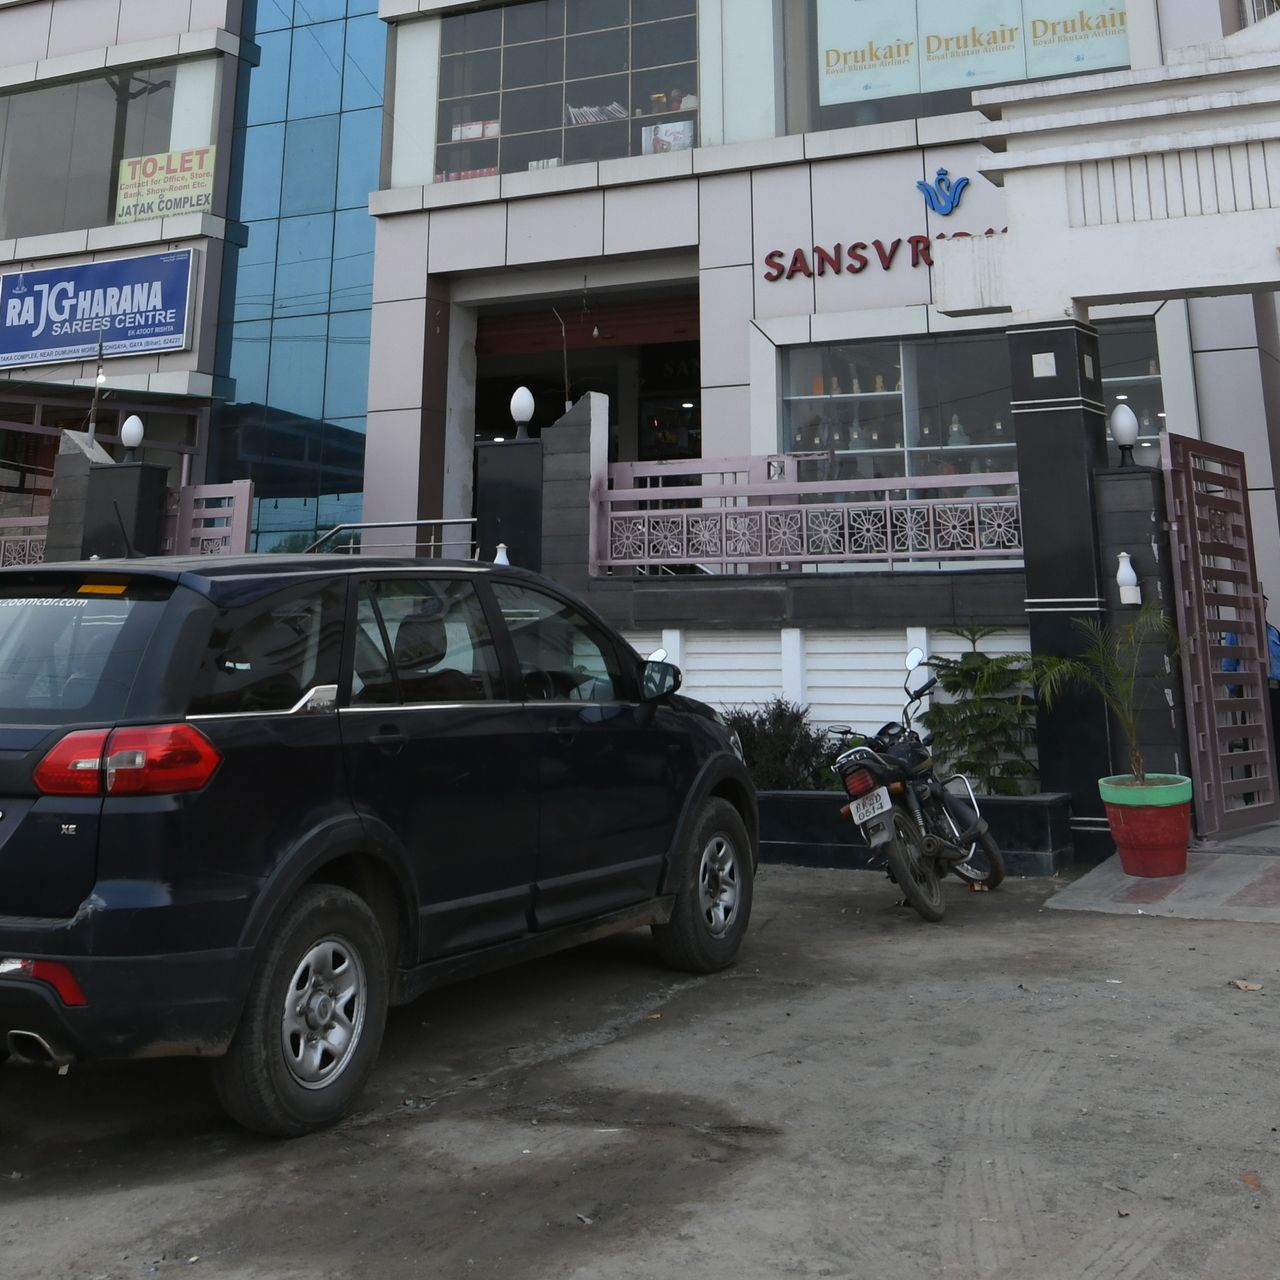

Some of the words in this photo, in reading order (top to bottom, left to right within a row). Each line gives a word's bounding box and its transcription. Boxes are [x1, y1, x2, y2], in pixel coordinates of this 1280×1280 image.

[1031, 7, 1127, 39] Drukair
[825, 38, 914, 68] Drukair
[926, 24, 1019, 54] Drukair
[127, 149, 210, 181] TO-LET
[119, 181, 149, 191] Contact
[150, 178, 161, 186] for
[118, 201, 154, 218] JATAK
[158, 193, 211, 212] COMPLEX
[764, 226, 1008, 282] SANSVR
[5, 280, 163, 338] RAJGHARANA
[51, 317, 111, 336] SAREES
[115, 309, 177, 328] CENTRE
[61, 824, 77, 835] XE
